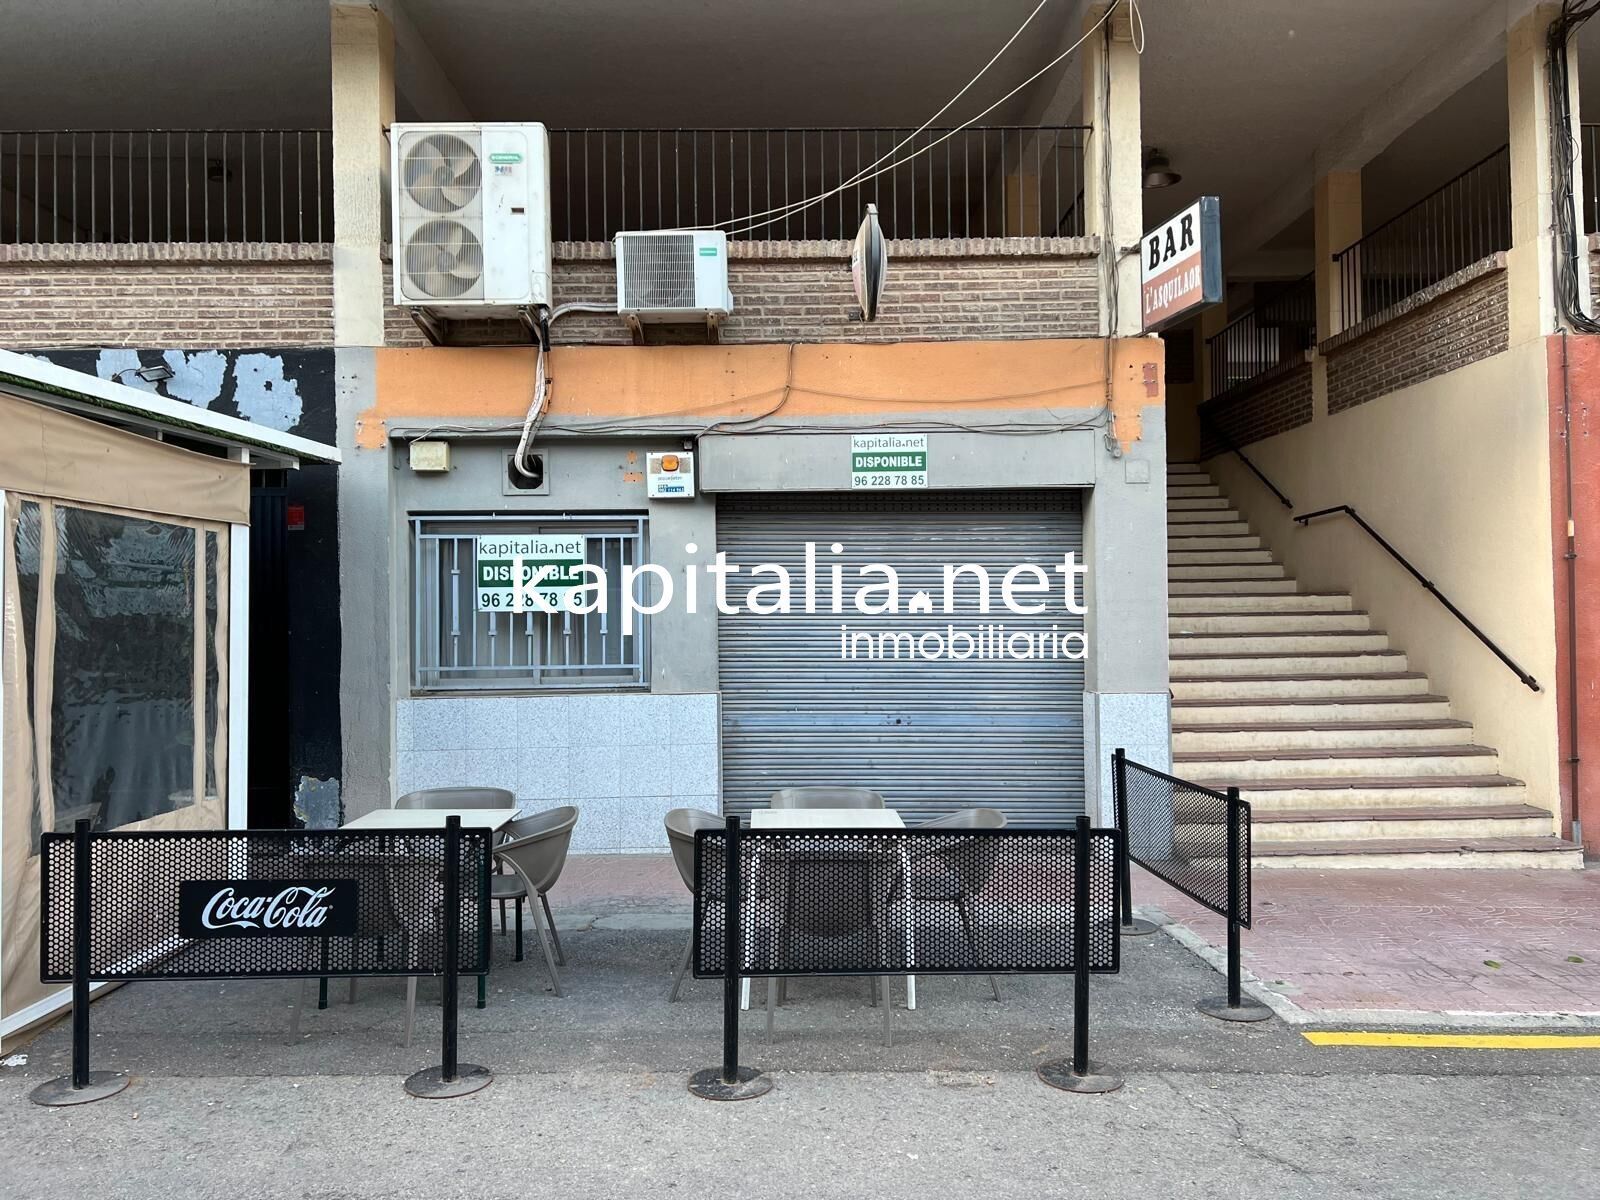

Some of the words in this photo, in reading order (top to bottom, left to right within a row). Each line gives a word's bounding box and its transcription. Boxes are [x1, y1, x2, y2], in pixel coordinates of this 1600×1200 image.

[1149, 213, 1194, 271] BAR
[853, 436, 924, 450] kapitalia.net
[855, 456, 922, 467] DISPONIBLE
[854, 476, 868, 486] 96
[871, 475, 891, 486] 228
[894, 475, 908, 486] 78
[911, 475, 924, 485] 85
[479, 540, 581, 557] kapitalia.net
[481, 593, 500, 607] 96
[505, 593, 534, 607] 28
[564, 592, 582, 606] 5
[201, 886, 336, 929] Coca-Cola
